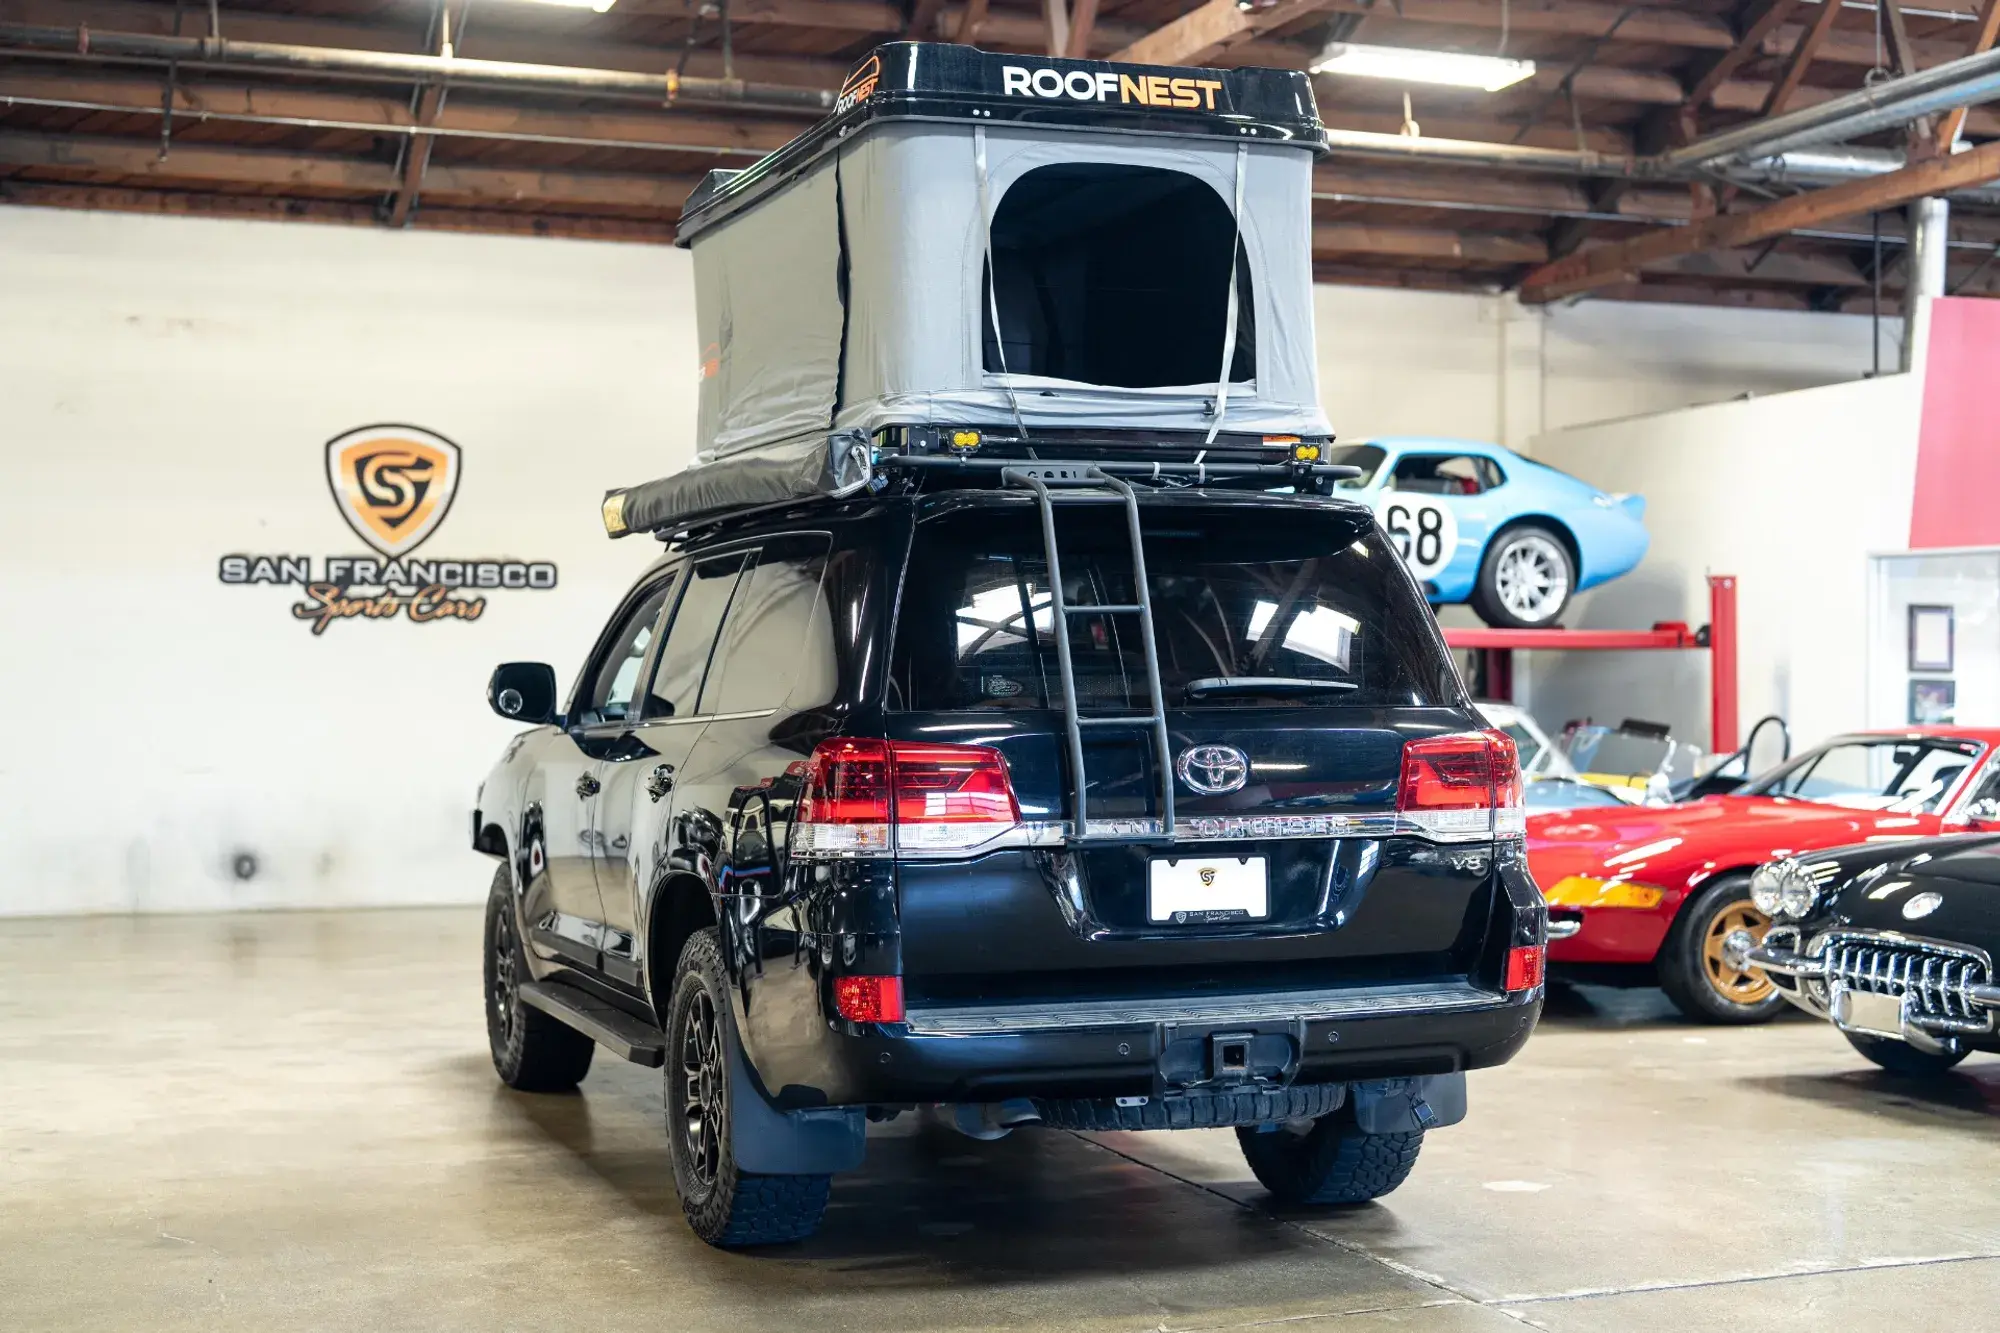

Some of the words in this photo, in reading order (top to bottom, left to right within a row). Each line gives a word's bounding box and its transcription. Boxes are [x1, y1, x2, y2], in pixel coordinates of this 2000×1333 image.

[1002, 65, 1222, 111] ROOFNEST
[1387, 505, 1443, 566] 68
[219, 555, 310, 588] SAN
[326, 558, 558, 589] FRANCISCO
[291, 581, 399, 636] Sports
[407, 583, 487, 623] Cars
[1450, 855, 1481, 870] V8
